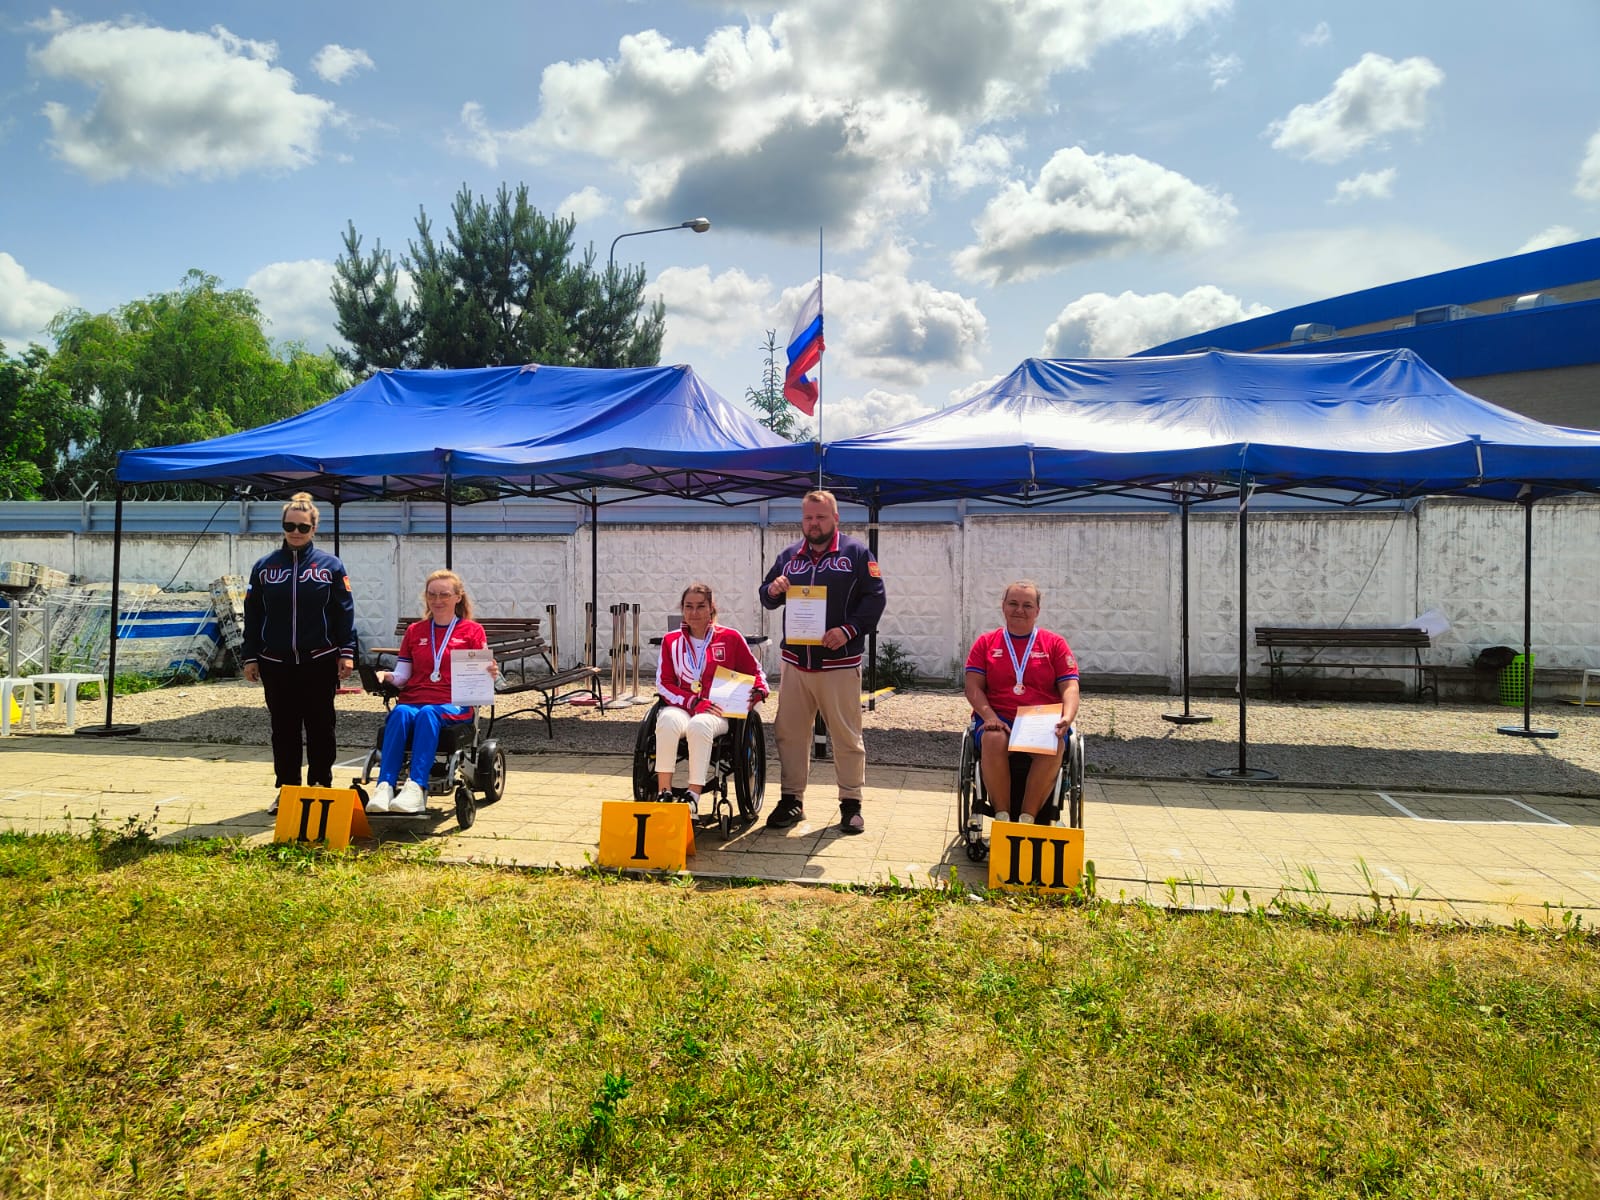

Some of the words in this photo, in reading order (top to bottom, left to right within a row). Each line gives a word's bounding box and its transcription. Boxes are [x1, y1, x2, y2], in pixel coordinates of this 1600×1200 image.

[296, 798, 335, 842] II
[631, 814, 651, 860] I
[1004, 835, 1070, 888] III
